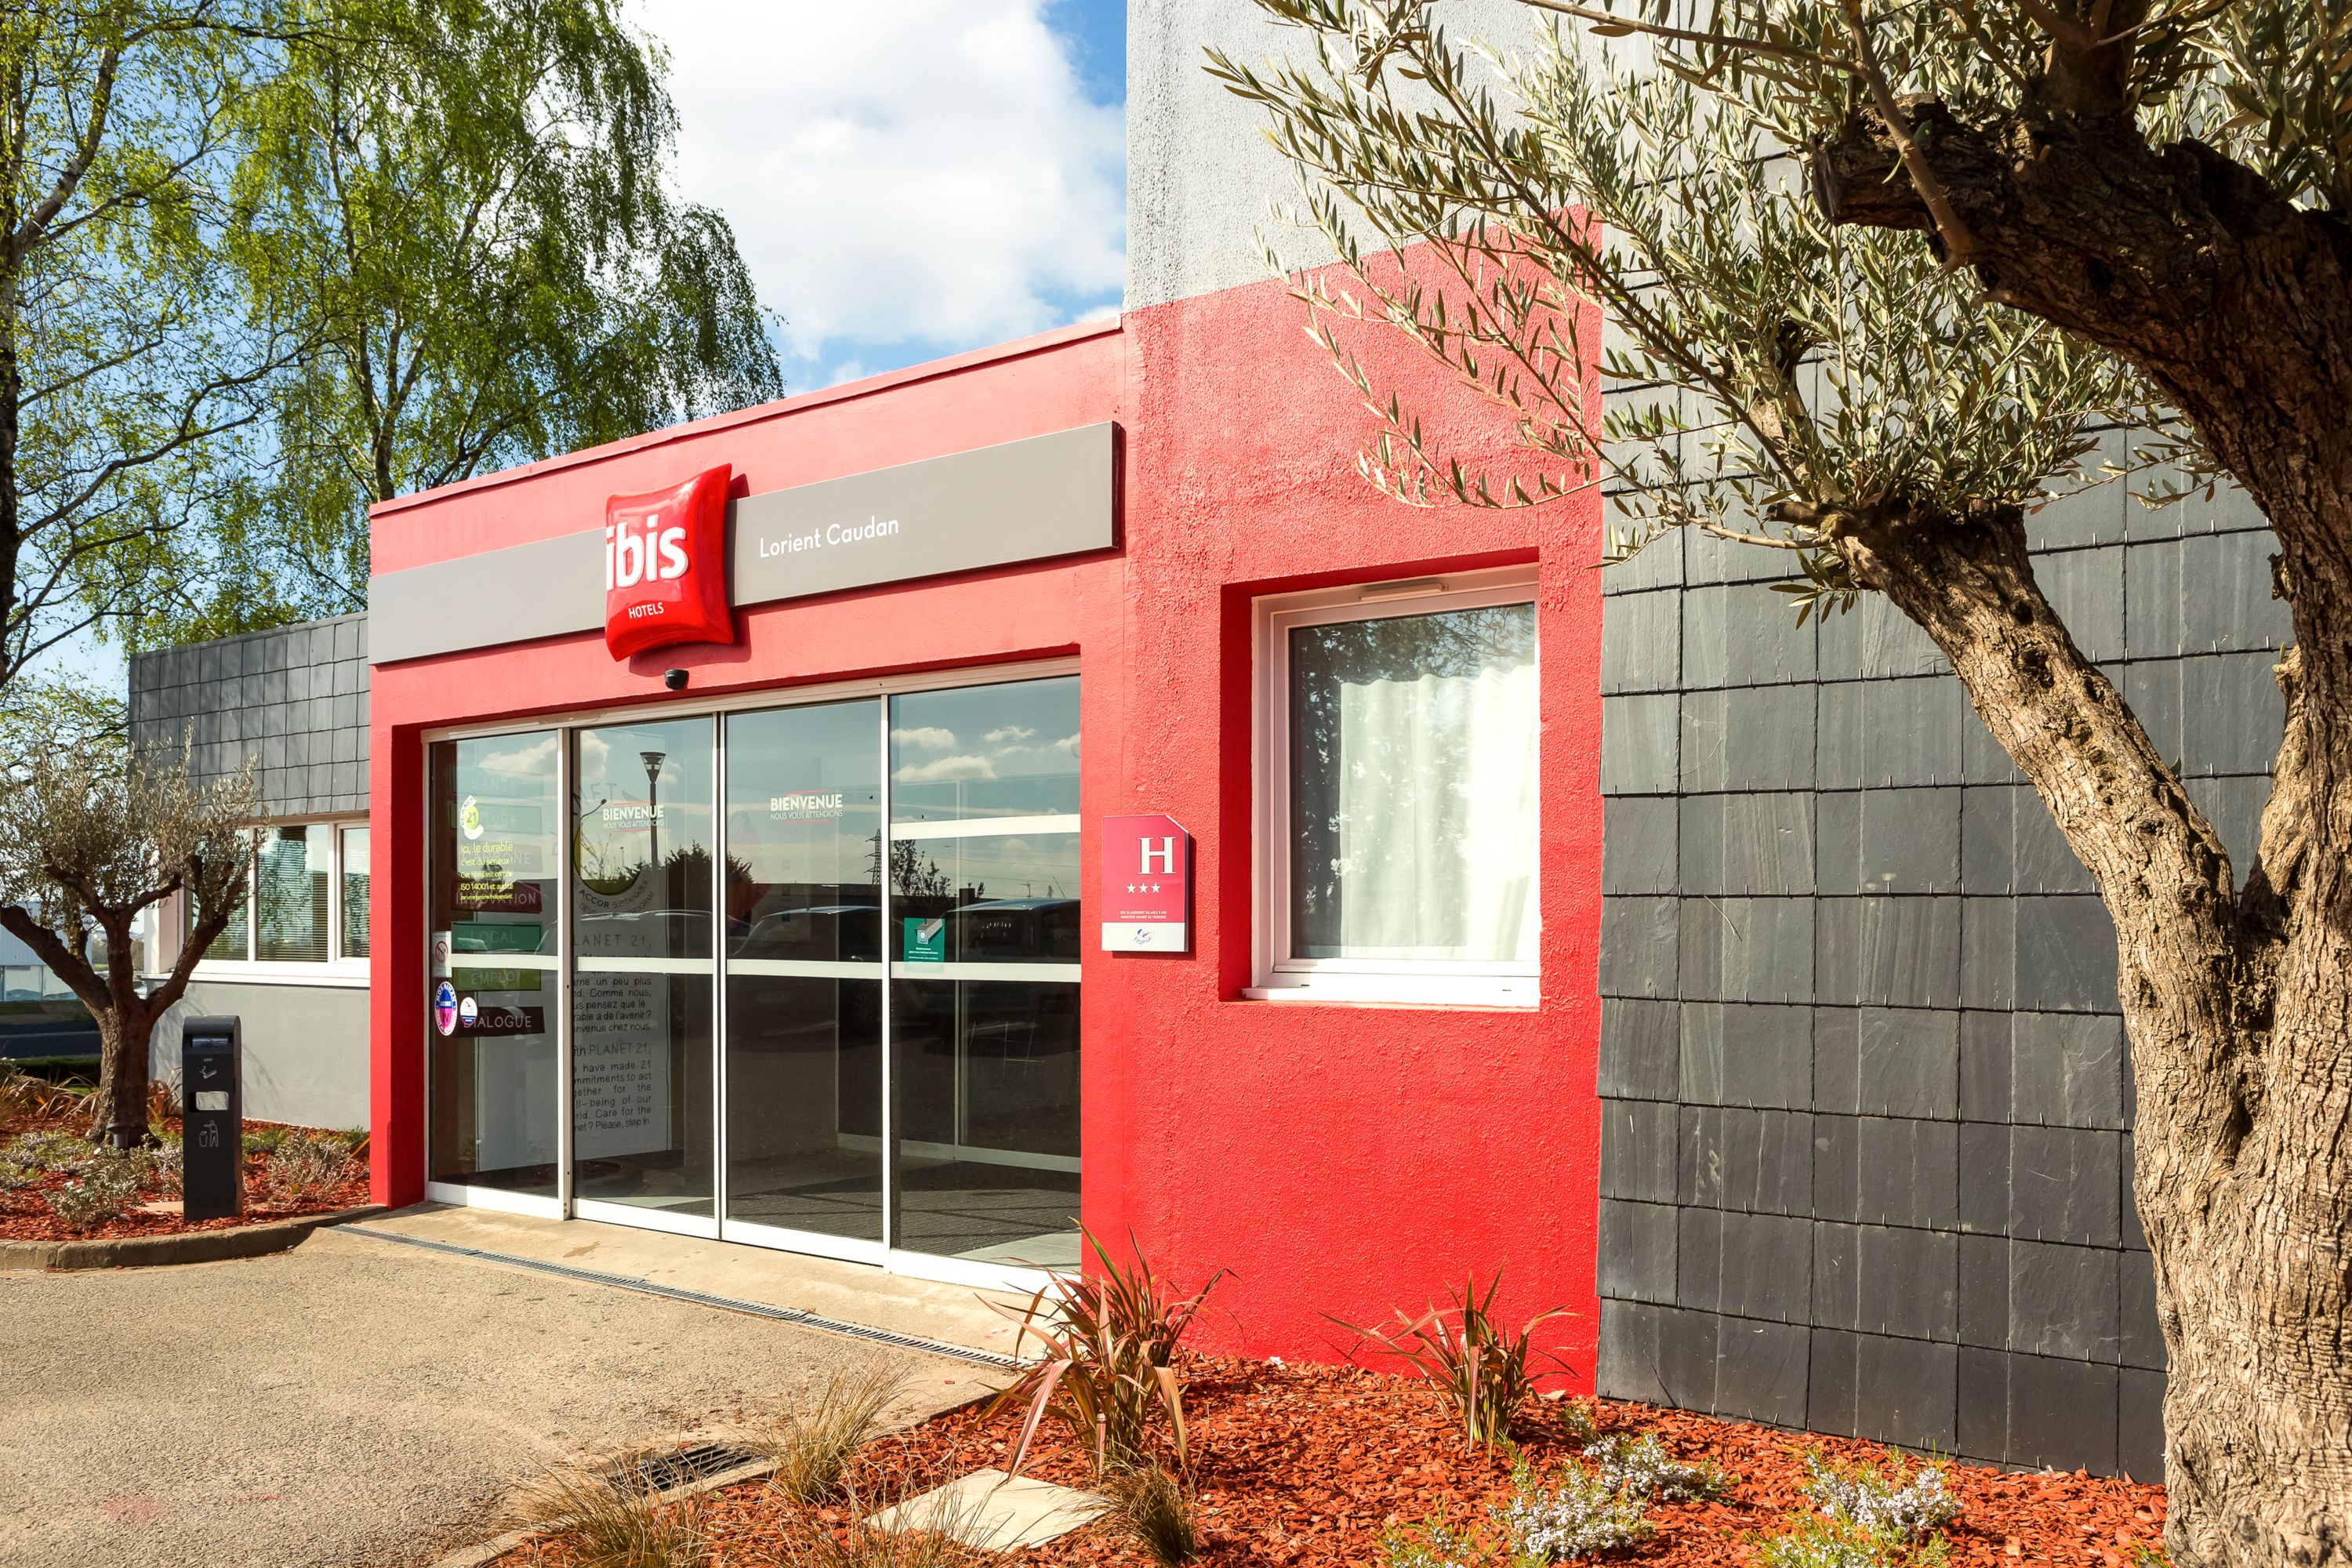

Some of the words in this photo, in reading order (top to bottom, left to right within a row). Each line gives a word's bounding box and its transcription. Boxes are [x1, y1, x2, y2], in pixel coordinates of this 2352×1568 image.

[760, 528, 821, 558] Lorient
[826, 514, 899, 546] Caudan
[606, 514, 689, 590] ibis
[629, 601, 665, 619] HOTELS
[770, 793, 843, 811] BIENVENUE
[466, 811, 477, 823] 21
[602, 804, 664, 821] BIENVENUE
[770, 811, 787, 820] NOUS
[788, 810, 804, 819] VOUS
[806, 809, 843, 818] ATTENDIONS
[633, 819, 665, 828] ATTENDIONS
[460, 843, 471, 855] Ici,
[473, 842, 481, 853] le
[482, 840, 514, 852] durable
[460, 858, 476, 866] c'est
[477, 857, 485, 866] du
[1137, 837, 1178, 875] H
[471, 882, 489, 891] 14001
[579, 889, 610, 909] ACCOR
[574, 935, 621, 946] LANET
[630, 935, 652, 949] 21,
[613, 978, 629, 987] peu
[634, 976, 652, 986] plus
[590, 989, 624, 997] Comme
[628, 989, 652, 998] nous,
[586, 1000, 618, 1011] pensez
[620, 1000, 636, 1011] que
[638, 999, 645, 1008] le
[604, 1011, 614, 1020] de
[615, 1011, 644, 1020] l'avenir
[608, 1022, 628, 1032] chez
[589, 1042, 633, 1055] PLANET
[636, 1042, 652, 1056] 21,
[583, 1063, 605, 1073] have
[611, 1061, 636, 1071] made
[640, 1060, 652, 1069] 21
[627, 1073, 636, 1082] to
[638, 1072, 652, 1080] act
[613, 1084, 626, 1094] for
[637, 1083, 652, 1092] the
[622, 1095, 631, 1105] of
[637, 1094, 652, 1104] our
[595, 1109, 618, 1119] Care
[622, 1107, 633, 1116] for
[637, 1105, 652, 1115] the
[595, 1120, 624, 1130] Please,
[625, 1118, 641, 1128] step
